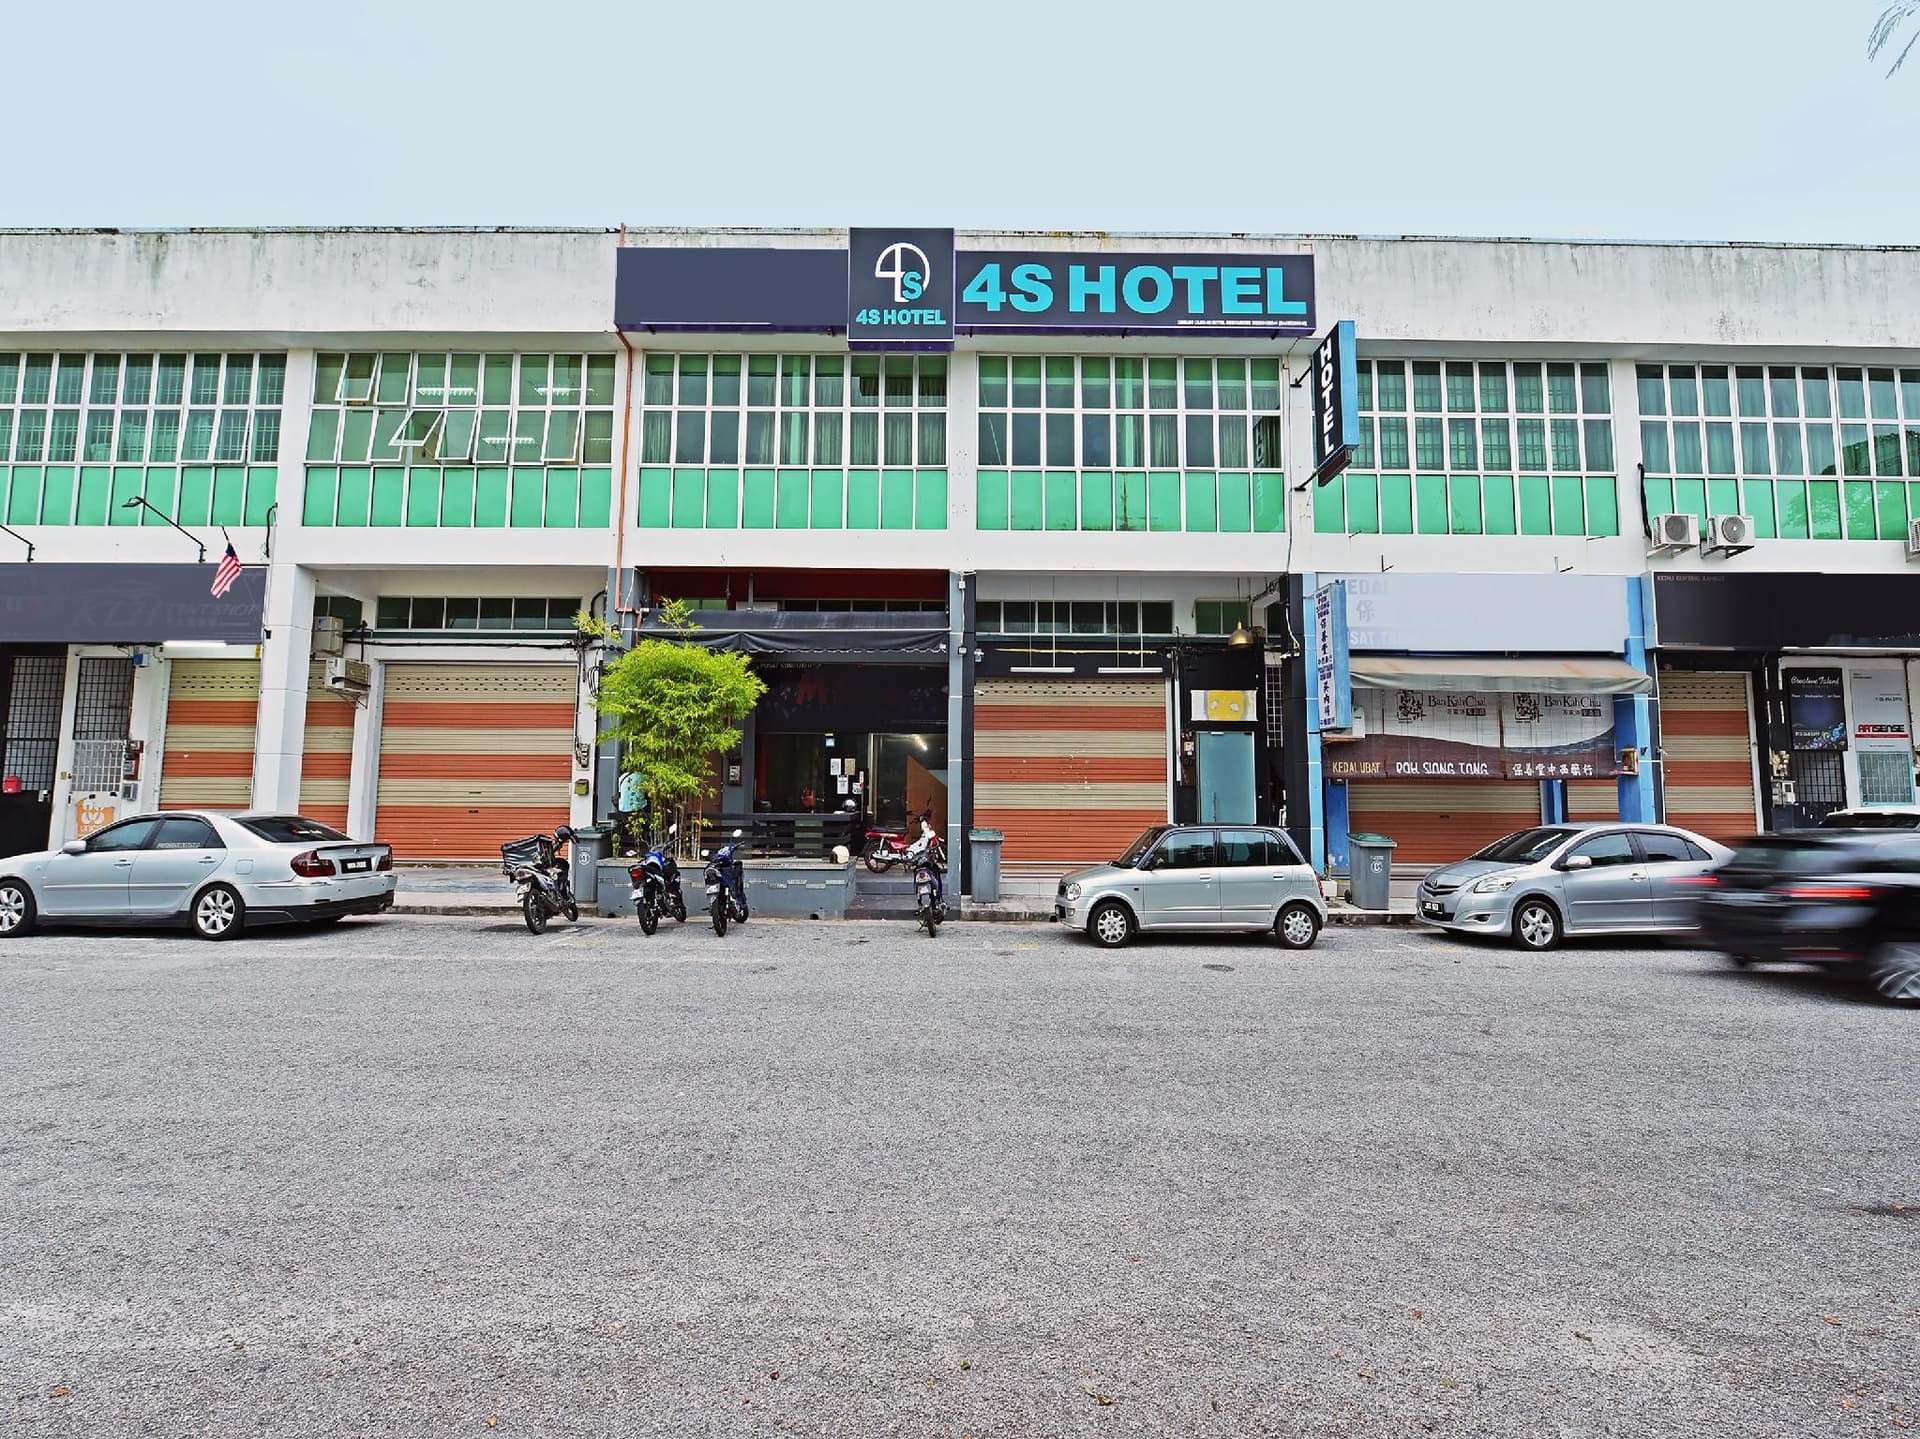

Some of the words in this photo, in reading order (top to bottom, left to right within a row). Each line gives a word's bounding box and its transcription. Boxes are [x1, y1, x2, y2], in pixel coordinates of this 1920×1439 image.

[962, 262, 1055, 314] 4S
[1068, 264, 1307, 315] HOTEL
[855, 308, 881, 325] 4S
[883, 308, 947, 325] HOTEL
[1319, 336, 1335, 457] HOTEL
[1332, 761, 1357, 774] KEDAI
[1360, 761, 1380, 774] UBAT
